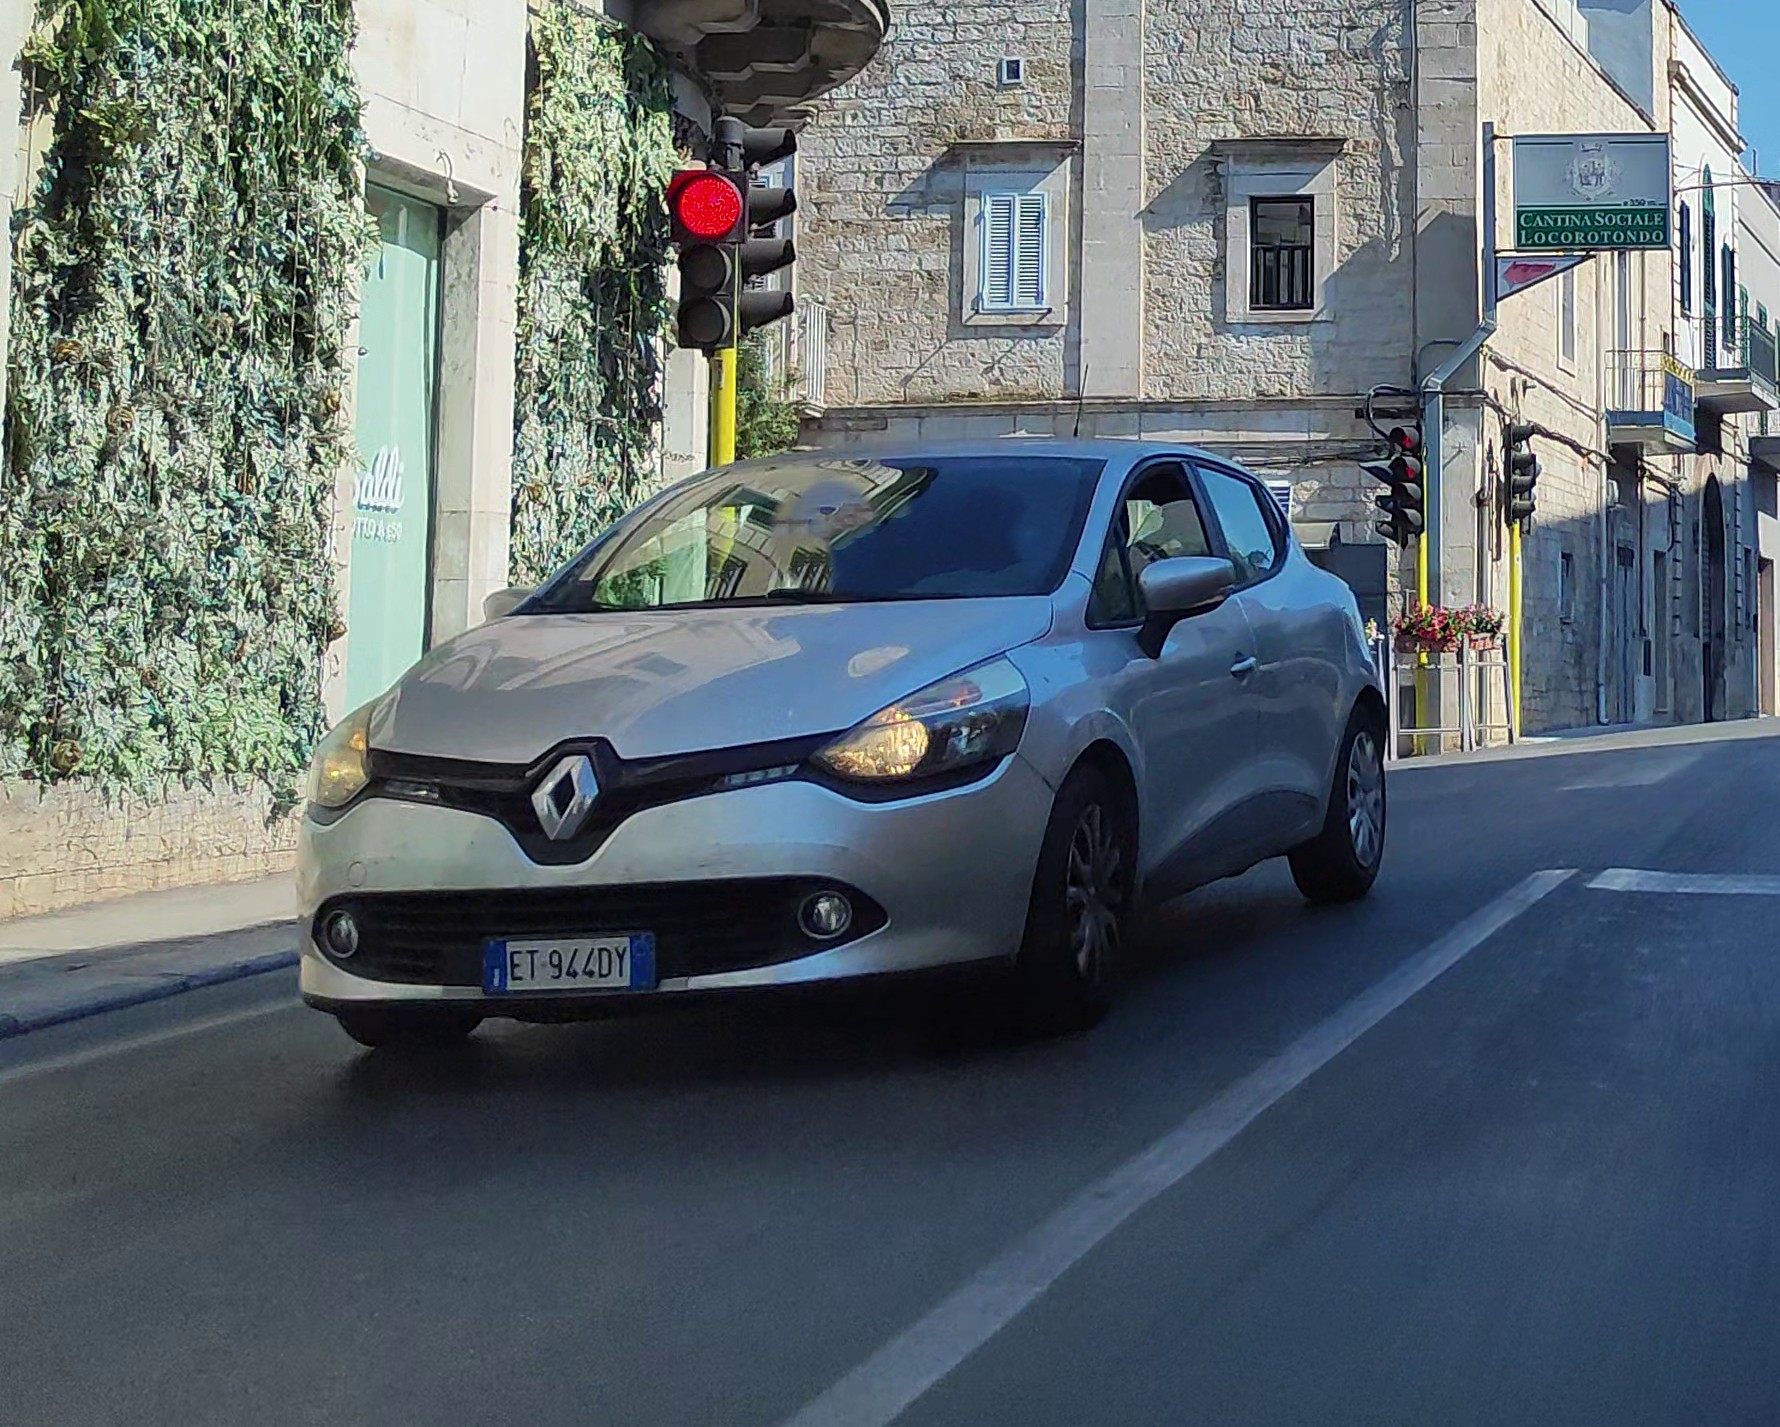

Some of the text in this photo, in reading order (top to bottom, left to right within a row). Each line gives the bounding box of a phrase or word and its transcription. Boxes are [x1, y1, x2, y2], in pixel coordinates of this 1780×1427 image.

[1520, 211, 1664, 228] CANTINA SOCIALE
[1520, 229, 1664, 244] LOCOROTONDO
[509, 947, 626, 981] ET 944DY
